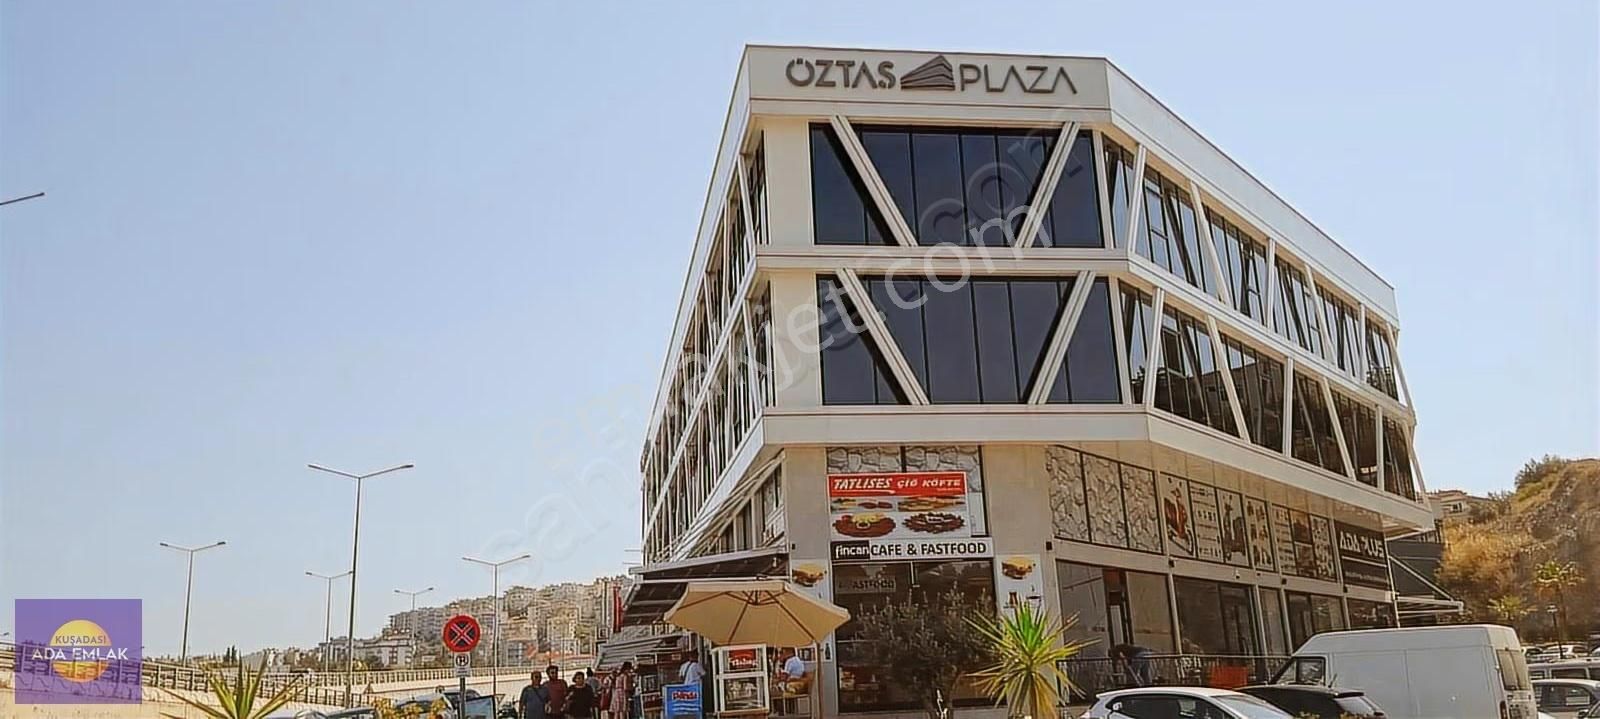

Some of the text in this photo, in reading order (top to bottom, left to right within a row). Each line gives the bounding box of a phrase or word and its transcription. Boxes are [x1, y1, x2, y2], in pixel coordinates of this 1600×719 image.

[959, 63, 1078, 94] PLAZA
[835, 542, 987, 559] fincan CAFE & FASTFOOD
